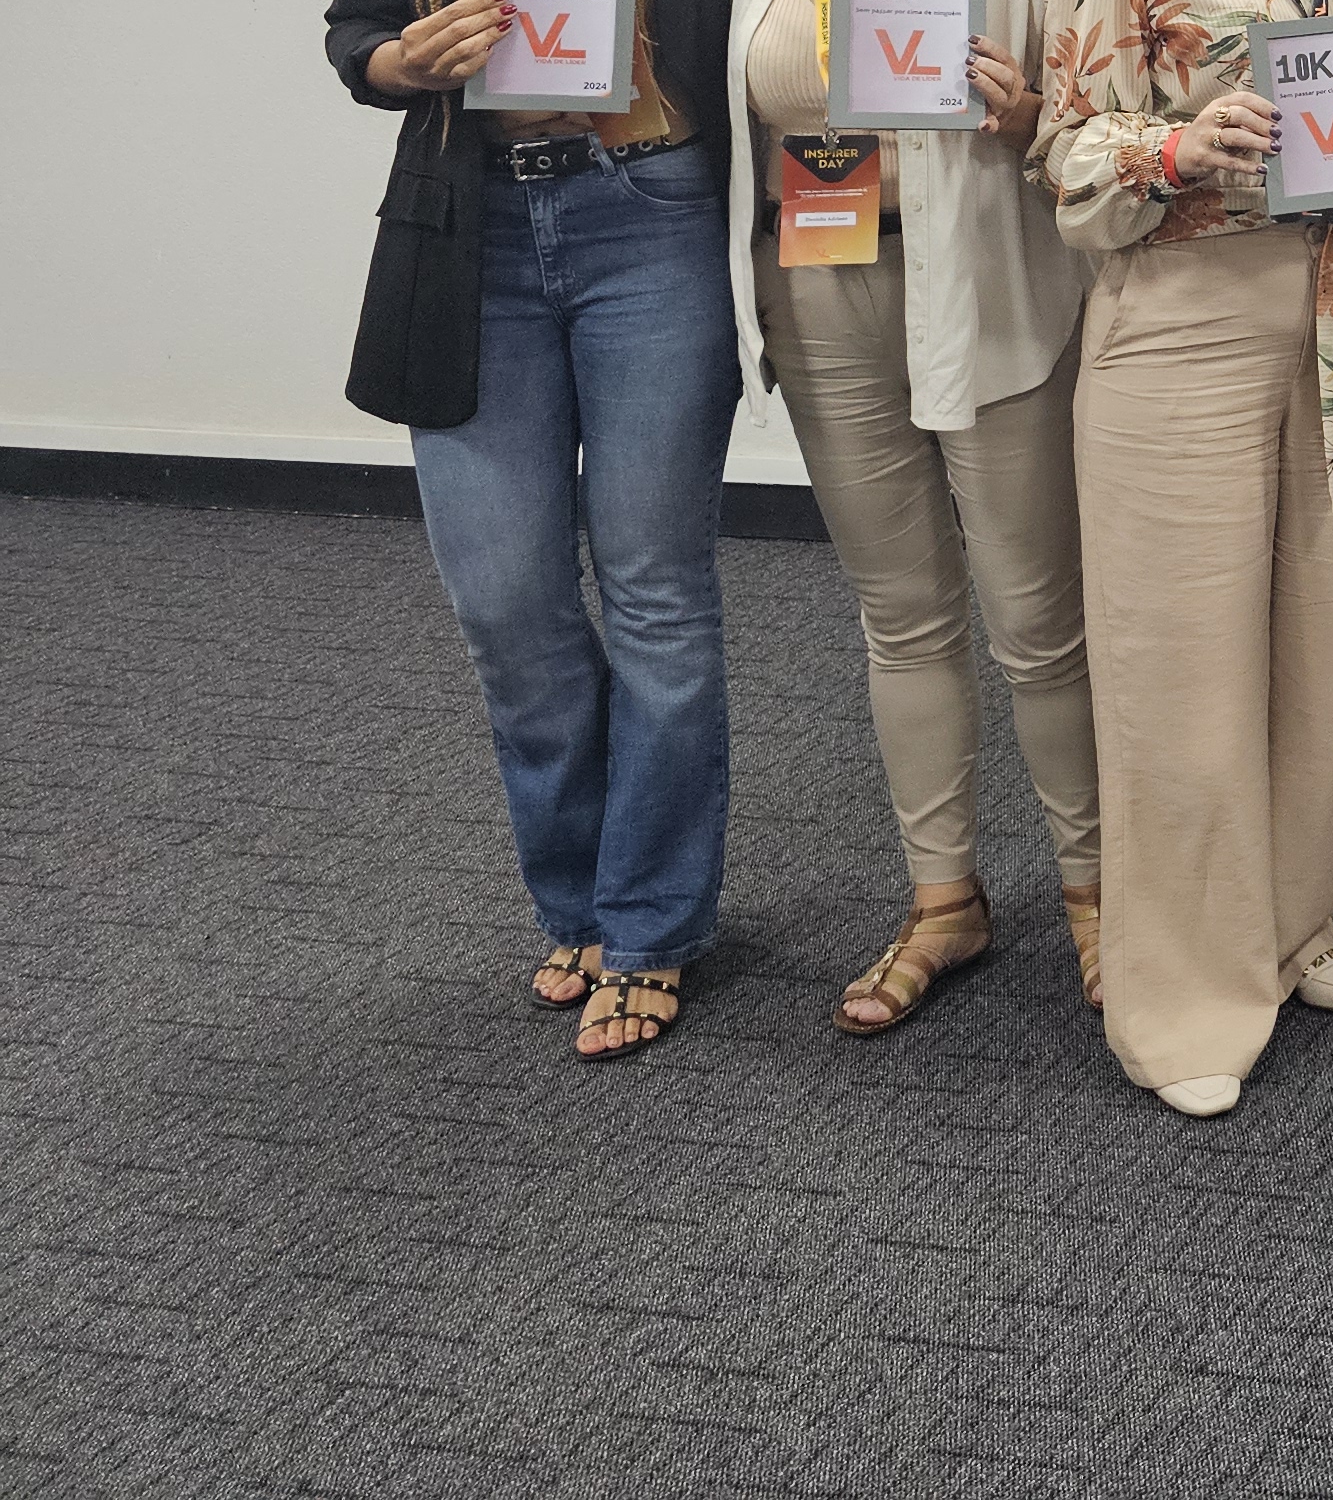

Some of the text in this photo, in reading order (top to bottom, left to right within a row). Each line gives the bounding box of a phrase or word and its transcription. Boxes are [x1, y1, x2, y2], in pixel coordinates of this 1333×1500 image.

[517, 12, 586, 58] VL
[874, 29, 941, 75] VL
[584, 82, 607, 90] 2024
[1294, 90, 1314, 99] passar
[940, 98, 962, 106] 2024
[804, 149, 858, 159] INSPIRER
[819, 159, 844, 169] DAY
